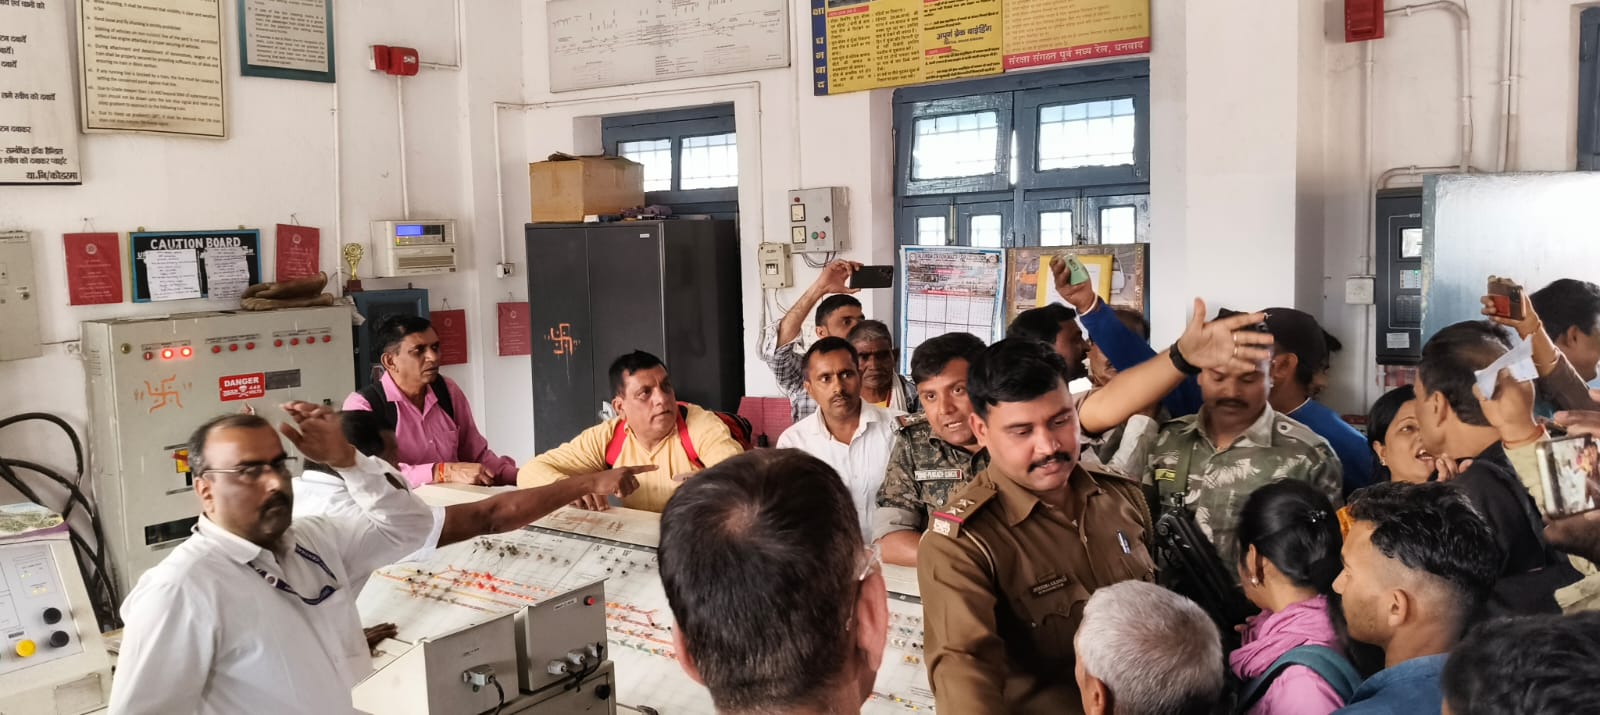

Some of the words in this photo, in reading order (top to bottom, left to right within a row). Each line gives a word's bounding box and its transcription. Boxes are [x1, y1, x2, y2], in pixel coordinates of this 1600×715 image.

[150, 238, 204, 250] CAUTION
[205, 236, 241, 249] BOARD
[224, 377, 259, 387] DANGER
